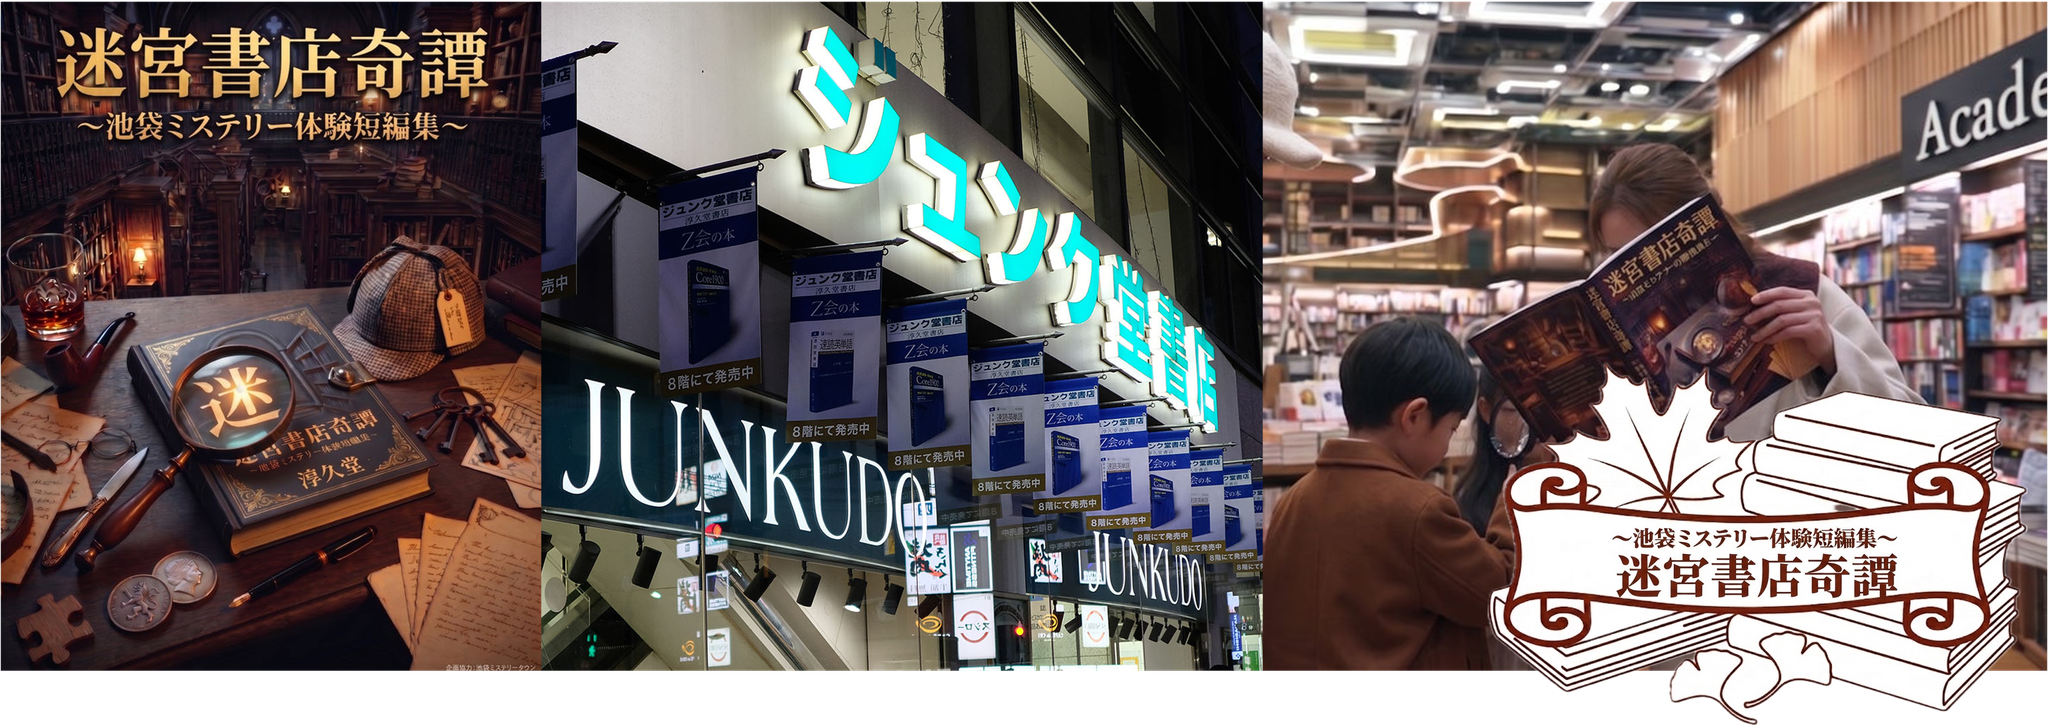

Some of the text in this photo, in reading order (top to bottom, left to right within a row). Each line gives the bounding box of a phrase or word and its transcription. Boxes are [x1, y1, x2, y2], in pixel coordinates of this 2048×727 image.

[56, 27, 488, 99] 迷宮書店奇譚
[541, 66, 571, 88] 書店
[1916, 58, 2048, 163] Acade
[662, 188, 753, 218] ジュンク堂書店
[684, 208, 730, 226] 淳久堂書店
[791, 25, 1219, 434] ジュンク堂書店
[681, 228, 735, 251] Z会の本
[1603, 204, 1718, 299] 迷宮書店奇譚
[795, 269, 878, 287] ジュンク堂書店
[815, 284, 856, 295] 淳久堂書店
[810, 299, 860, 317] Z会の本
[889, 314, 963, 333] ジュンク堂書店
[904, 343, 949, 359] Z会の本
[973, 357, 1040, 373] ジュンク堂書店
[667, 365, 754, 390] 8階にて発売中
[987, 382, 1027, 397] Z会の本
[193, 366, 280, 438] 迷
[1046, 411, 1084, 425] Z会の本
[235, 408, 378, 467] 書店奇譚
[792, 422, 870, 438] 8階にて発売中
[894, 449, 965, 466] 8階にて発売中
[297, 455, 366, 490] 淳久堂
[562, 378, 927, 557] JUNKUDO
[977, 478, 1041, 492] 8階にて発売中
[1038, 498, 1097, 511] 8階にて発売中
[1090, 516, 1147, 527] 8階にて発売中
[1137, 532, 1188, 542] 8階にて発売中
[1175, 543, 1222, 553] 8階にて発売中
[1209, 551, 1254, 562] 8階にて発売中
[1088, 530, 1203, 611] JUNKUDO
